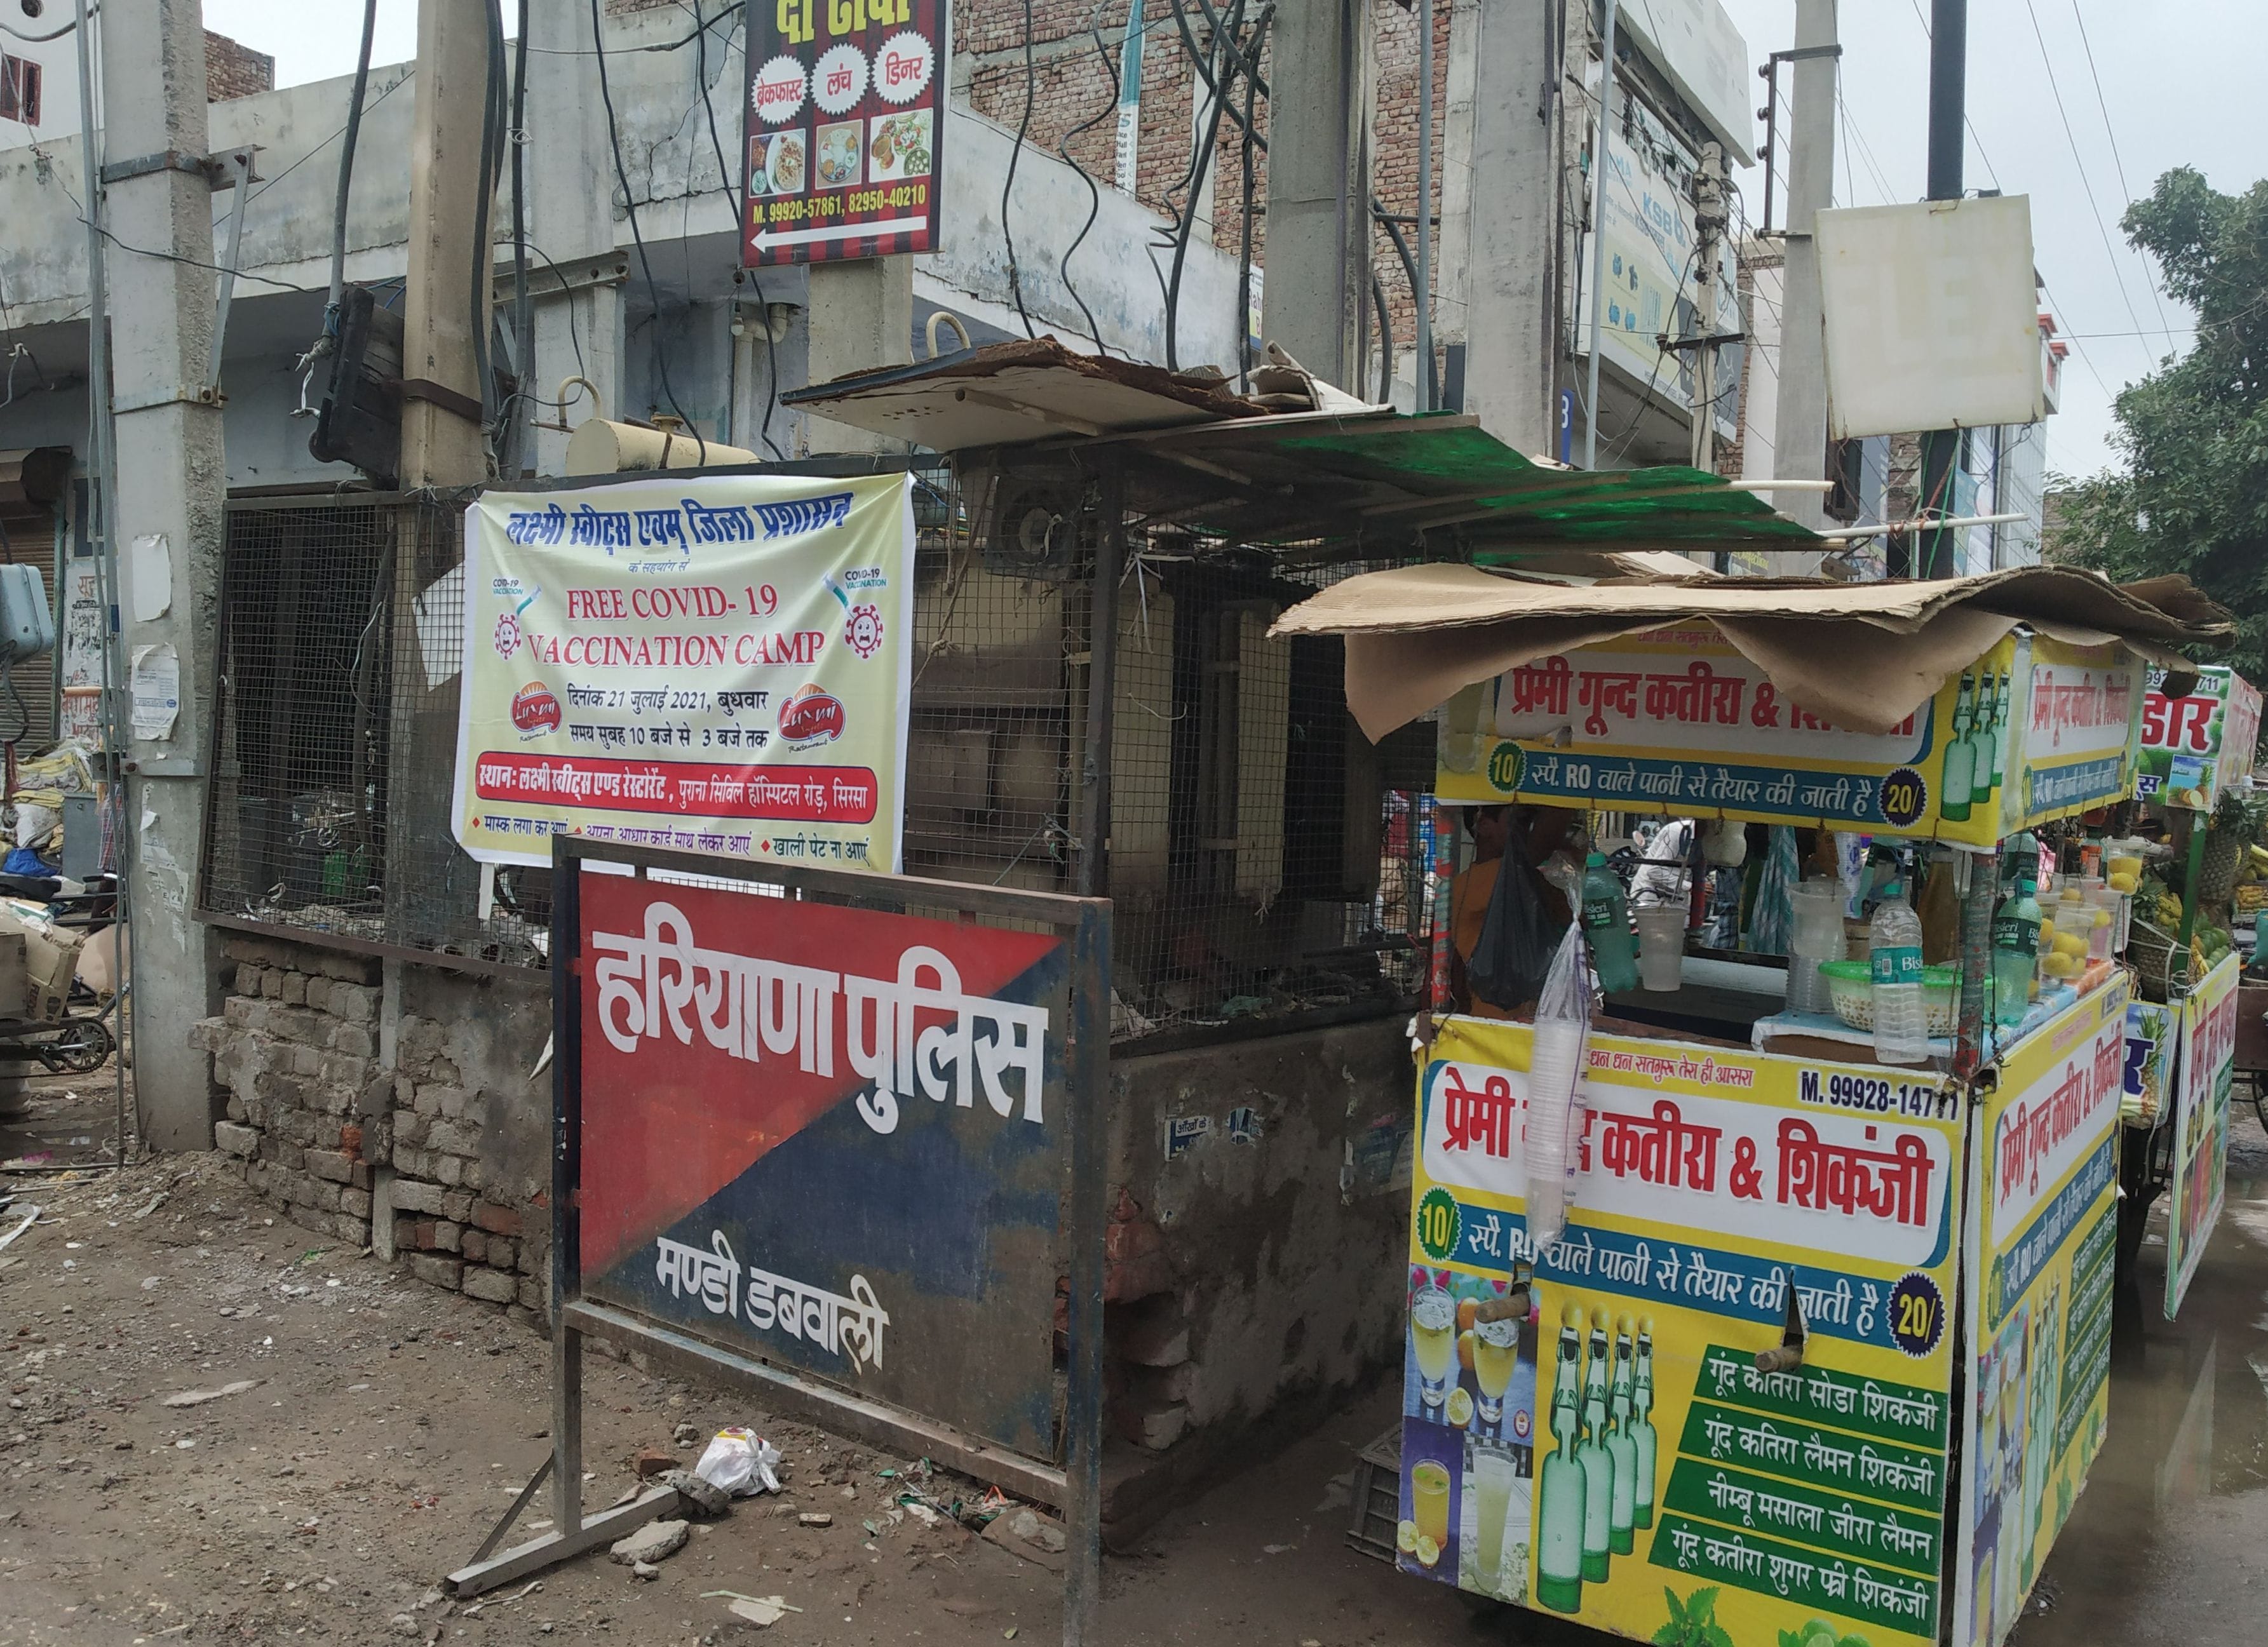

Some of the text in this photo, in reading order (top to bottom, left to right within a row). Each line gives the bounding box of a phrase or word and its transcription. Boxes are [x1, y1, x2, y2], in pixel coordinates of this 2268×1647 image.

[827, 63, 853, 95] लंच
[886, 51, 923, 85] डिनर
[757, 78, 803, 111] ब्रेकफास्ट
[753, 185, 926, 224] M. 99920-57861, 82950-40210
[1644, 192, 1672, 236] KSB
[506, 492, 853, 555] लक्ष्मी स्वीट्स एवम् जिला प्रशासन
[567, 589, 628, 619] FREE
[744, 584, 778, 617] 19
[528, 631, 825, 666] VACCINATION CAMP
[567, 683, 769, 716] दिनांक 21 जुलाई 2021, बुधवार
[1511, 655, 1574, 715] प्रेमी
[1579, 671, 1642, 736] गून्द
[1645, 661, 1746, 725] कतीरा
[1752, 683, 1779, 727] &
[569, 722, 769, 750] समय सुबह 10 बजे से 3 बजे तक
[2141, 693, 2218, 751] डार
[519, 762, 551, 791] लक्ष्मी
[551, 763, 593, 801] स्वीट्स
[593, 772, 621, 797] एण्ड
[678, 779, 708, 810] पुराना
[710, 774, 745, 803] सिविल
[747, 775, 800, 807] हॉस्पिटल
[832, 777, 868, 809] सिरसा
[1566, 764, 1591, 790] RO
[1598, 762, 1637, 792] वाले
[1639, 765, 1684, 797] पानी
[1687, 767, 1709, 799] से
[1711, 768, 1762, 803] तैयार
[1765, 774, 1797, 806] की
[1800, 778, 1851, 810] जाती
[1852, 779, 1873, 817] है
[484, 815, 511, 832] मास्क
[513, 818, 532, 835] लगा
[535, 820, 549, 837] कर
[619, 828, 648, 843] आधार
[650, 825, 672, 845] कार्ड
[675, 831, 694, 849] साथ
[698, 828, 725, 852] लेकर
[728, 831, 752, 856] आएं
[773, 833, 871, 867] खाली पेट ना आएं
[1901, 955, 1924, 971] Bisl
[592, 901, 1049, 1134] हरियाणा पुलिस
[1590, 1051, 1610, 1067] धन
[1612, 1053, 1633, 1071] धन
[1678, 1055, 1699, 1079] तेरा
[1700, 1058, 1713, 1085] ही
[1715, 1066, 1754, 1086] आसरा
[1801, 1072, 1824, 1103] M.
[1442, 1066, 1516, 1159] प्रेमी
[1602, 1100, 1722, 1192] कतीरा
[1730, 1137, 1763, 1200] &
[1776, 1117, 1934, 1227] शिकंजी
[656, 1229, 889, 1374] मण्डी डबवाली
[1550, 1232, 1595, 1275] वाले
[1599, 1241, 1652, 1286] पानी
[1656, 1247, 1682, 1292] से
[1684, 1251, 1745, 1305] तैयार
[1749, 1267, 1788, 1312] की
[1796, 1278, 1854, 1326] जाती
[1856, 1282, 1880, 1336] है
[1708, 1350, 1739, 1397] गूंद
[1807, 1371, 1858, 1414] सोडा
[1861, 1381, 1940, 1432] शिकंजी
[1704, 1413, 1936, 1497] गूंद कतिरा लैमन शिकंजी
[1707, 1472, 1933, 1560] नीम्बू मसाला जीरा लैमन
[1671, 1523, 1701, 1570] गूंद
[1704, 1535, 1765, 1576] कतीरा
[1768, 1555, 1814, 1596] शुगर
[1853, 1566, 1930, 1621] शिकंजी
